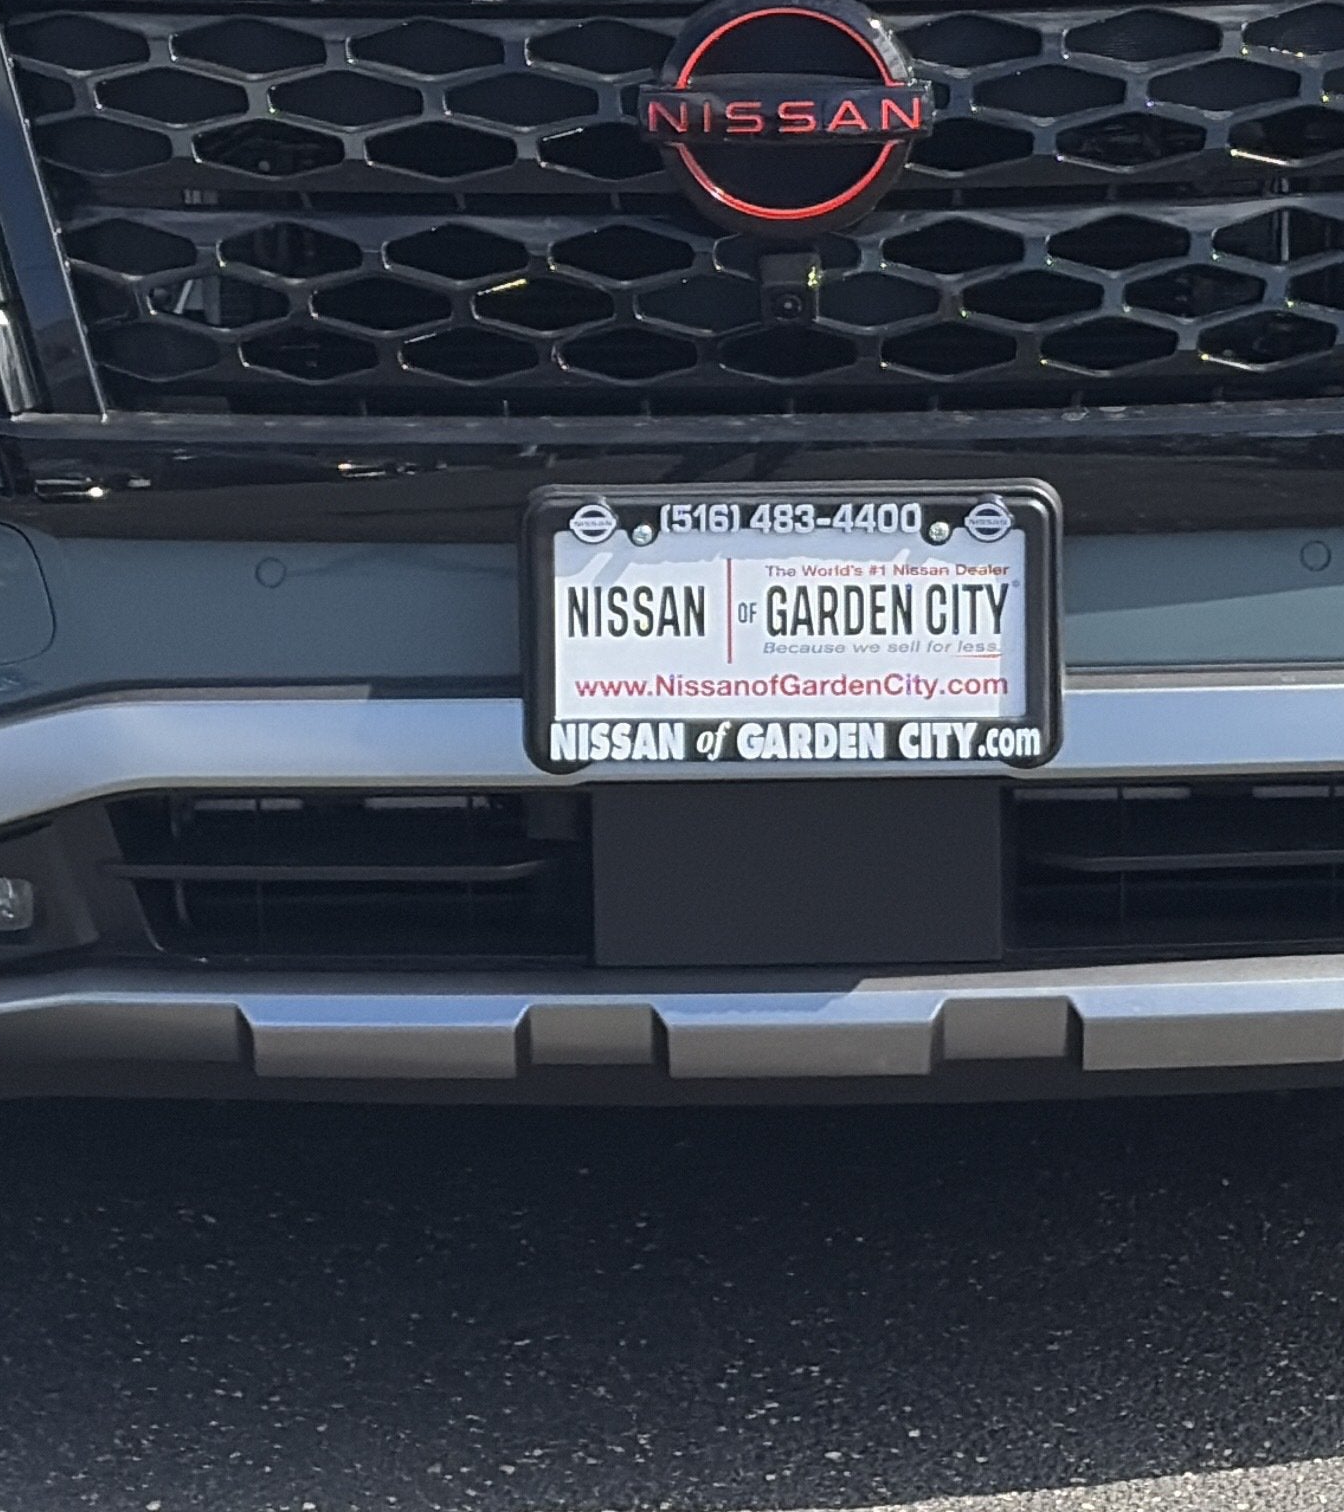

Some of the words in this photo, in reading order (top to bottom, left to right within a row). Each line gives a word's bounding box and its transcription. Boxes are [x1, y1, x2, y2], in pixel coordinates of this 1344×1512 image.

[647, 97, 921, 134] NISSAN
[660, 503, 741, 534] (516)
[749, 502, 922, 534] 483-4400
[765, 564, 796, 577] The
[802, 564, 863, 577] World's
[869, 565, 886, 577] #1
[893, 564, 949, 577] Nissan
[955, 563, 1011, 576] Dealer
[567, 585, 705, 638] NISSAN
[737, 602, 758, 624] OF
[766, 583, 913, 637] GARDEN
[926, 583, 1010, 636] CITY
[763, 641, 846, 654] Because
[853, 644, 881, 654] we
[887, 641, 920, 654] sell
[926, 641, 953, 654] for
[575, 673, 1009, 700] www.NissanofGardenCity.com
[550, 721, 686, 761] NISSAN
[696, 720, 732, 762] of
[736, 722, 885, 760] GARDEN
[898, 721, 1042, 760] CITY.com
